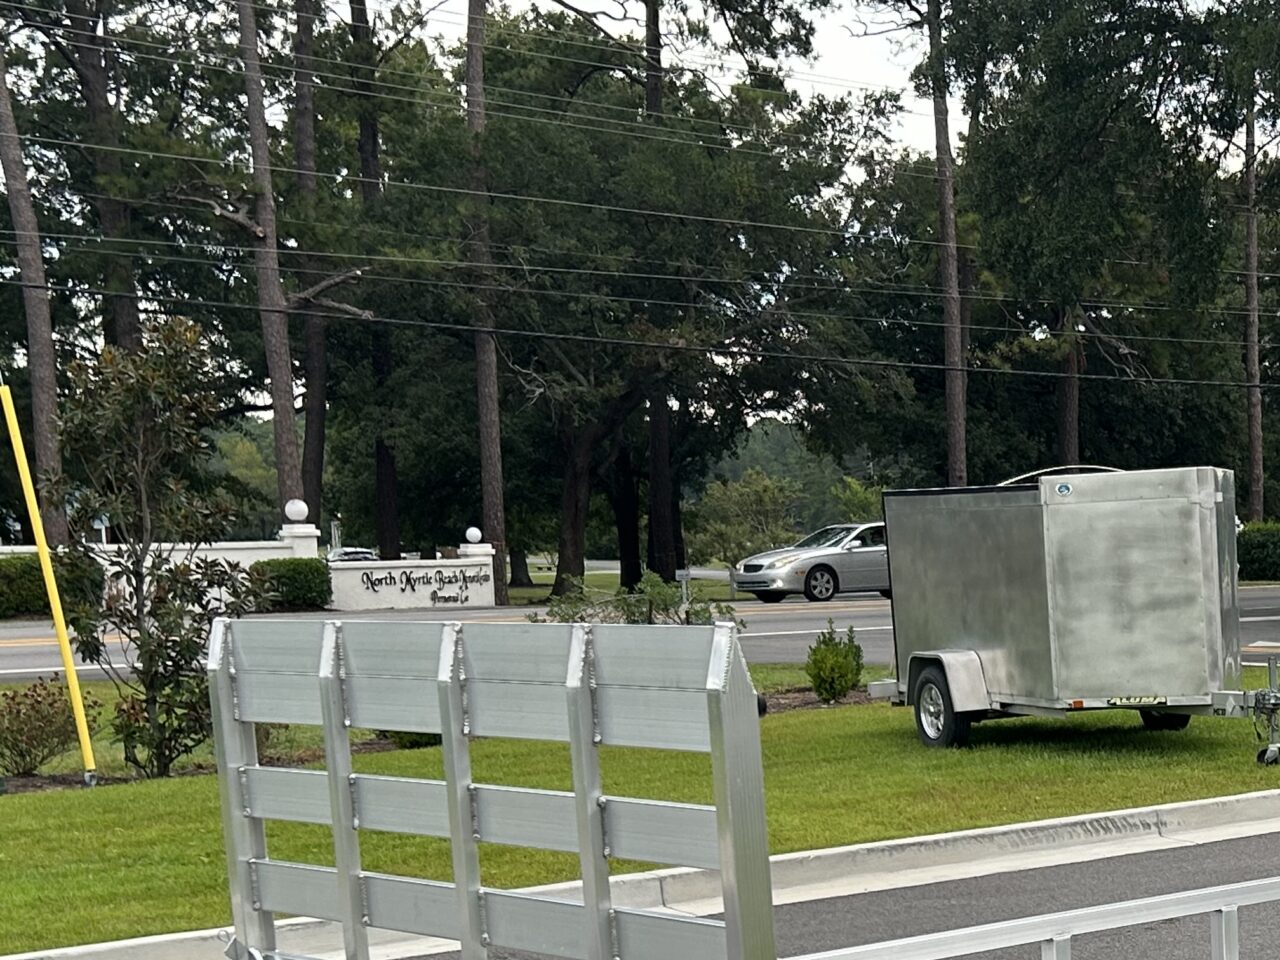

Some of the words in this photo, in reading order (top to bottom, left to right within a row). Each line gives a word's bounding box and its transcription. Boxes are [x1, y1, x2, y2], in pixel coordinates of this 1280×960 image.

[361, 571, 397, 593] North
[400, 570, 432, 593] Myrtle
[434, 569, 458, 591] Beach
[1109, 696, 1167, 706] ALUMA
